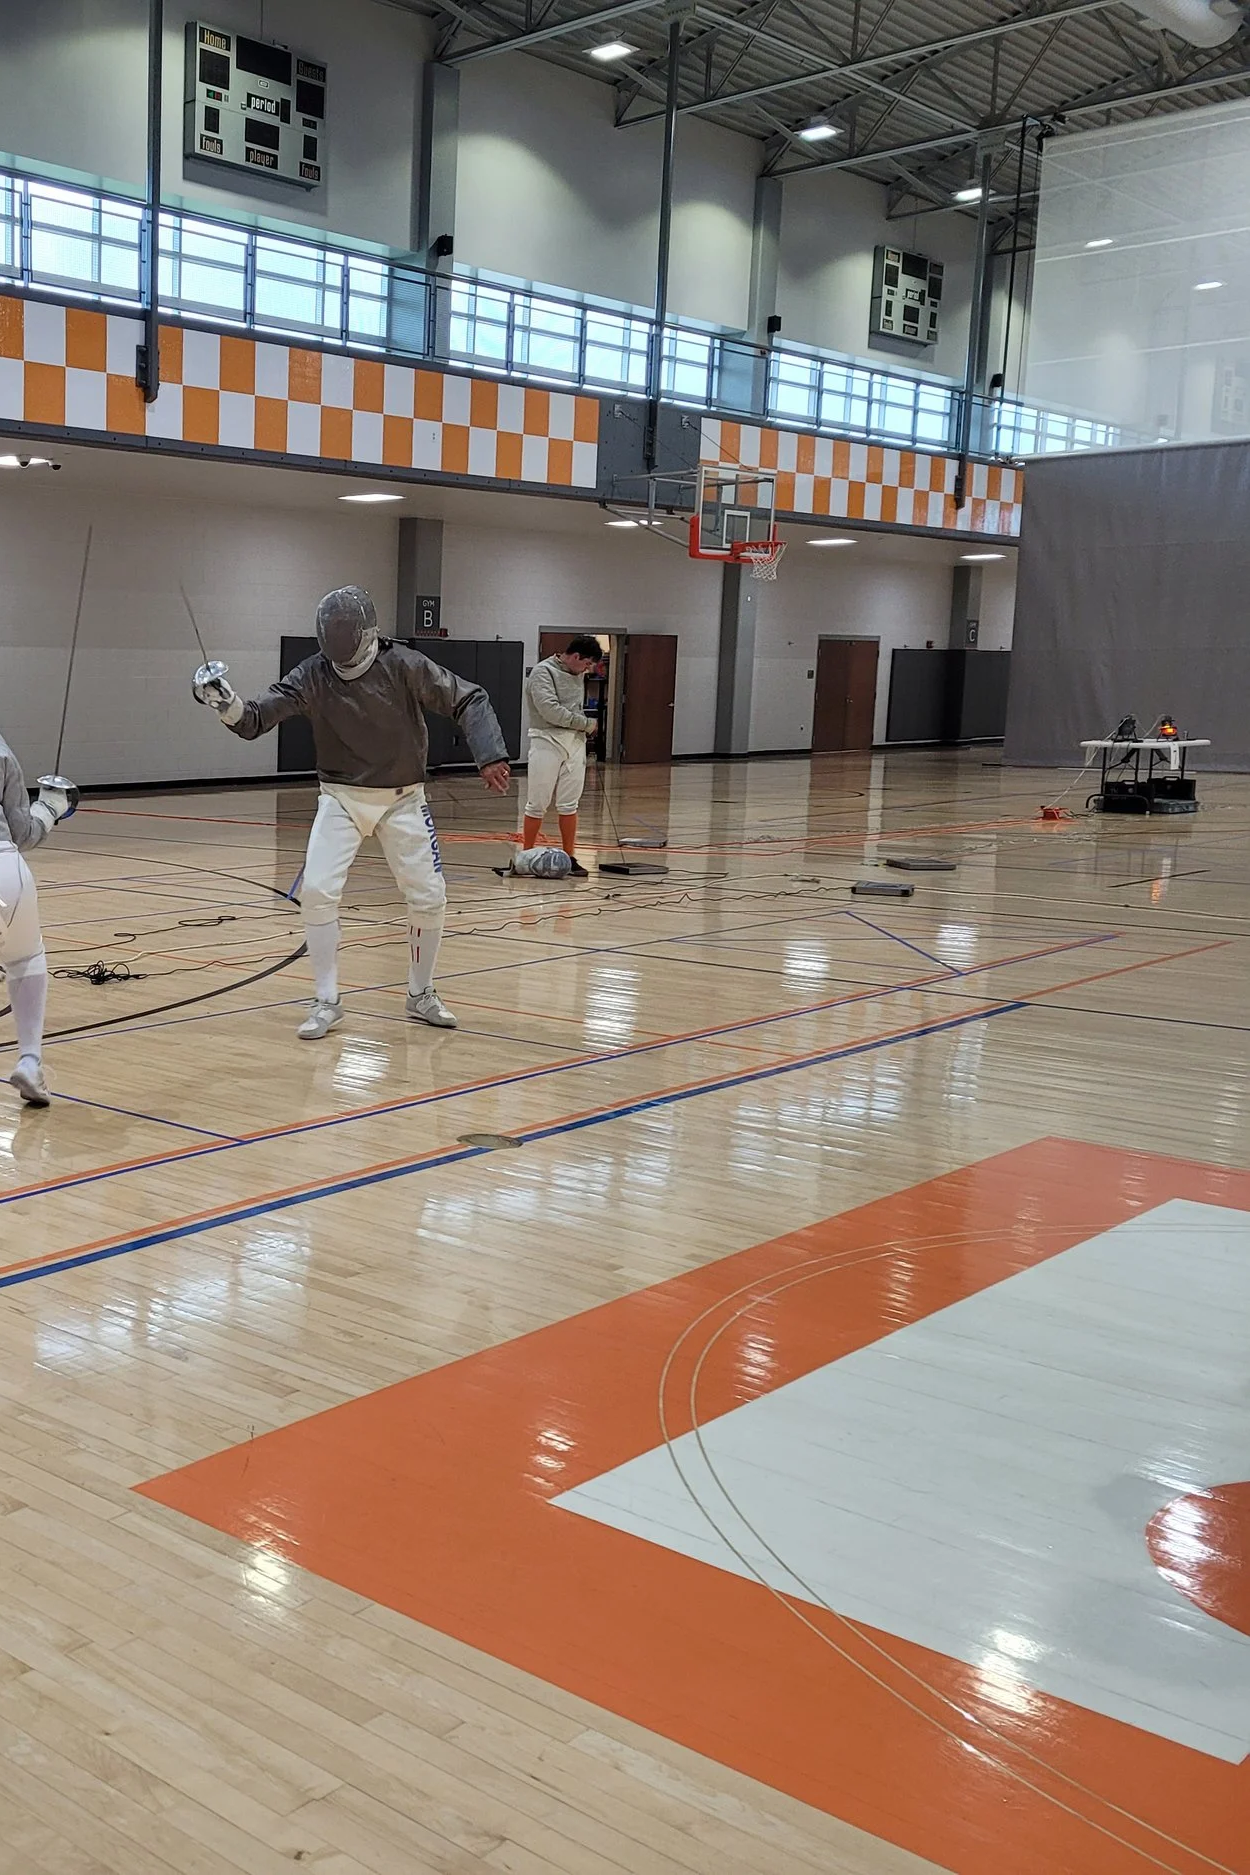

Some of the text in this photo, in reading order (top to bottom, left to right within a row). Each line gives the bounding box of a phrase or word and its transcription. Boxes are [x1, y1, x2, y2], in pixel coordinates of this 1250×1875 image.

[204, 29, 227, 50] Home
[298, 61, 324, 82] Guests
[251, 96, 276, 114] period
[202, 136, 221, 154] fouls
[250, 150, 275, 167] player
[301, 163, 319, 180] fouls
[423, 610, 433, 628] B
